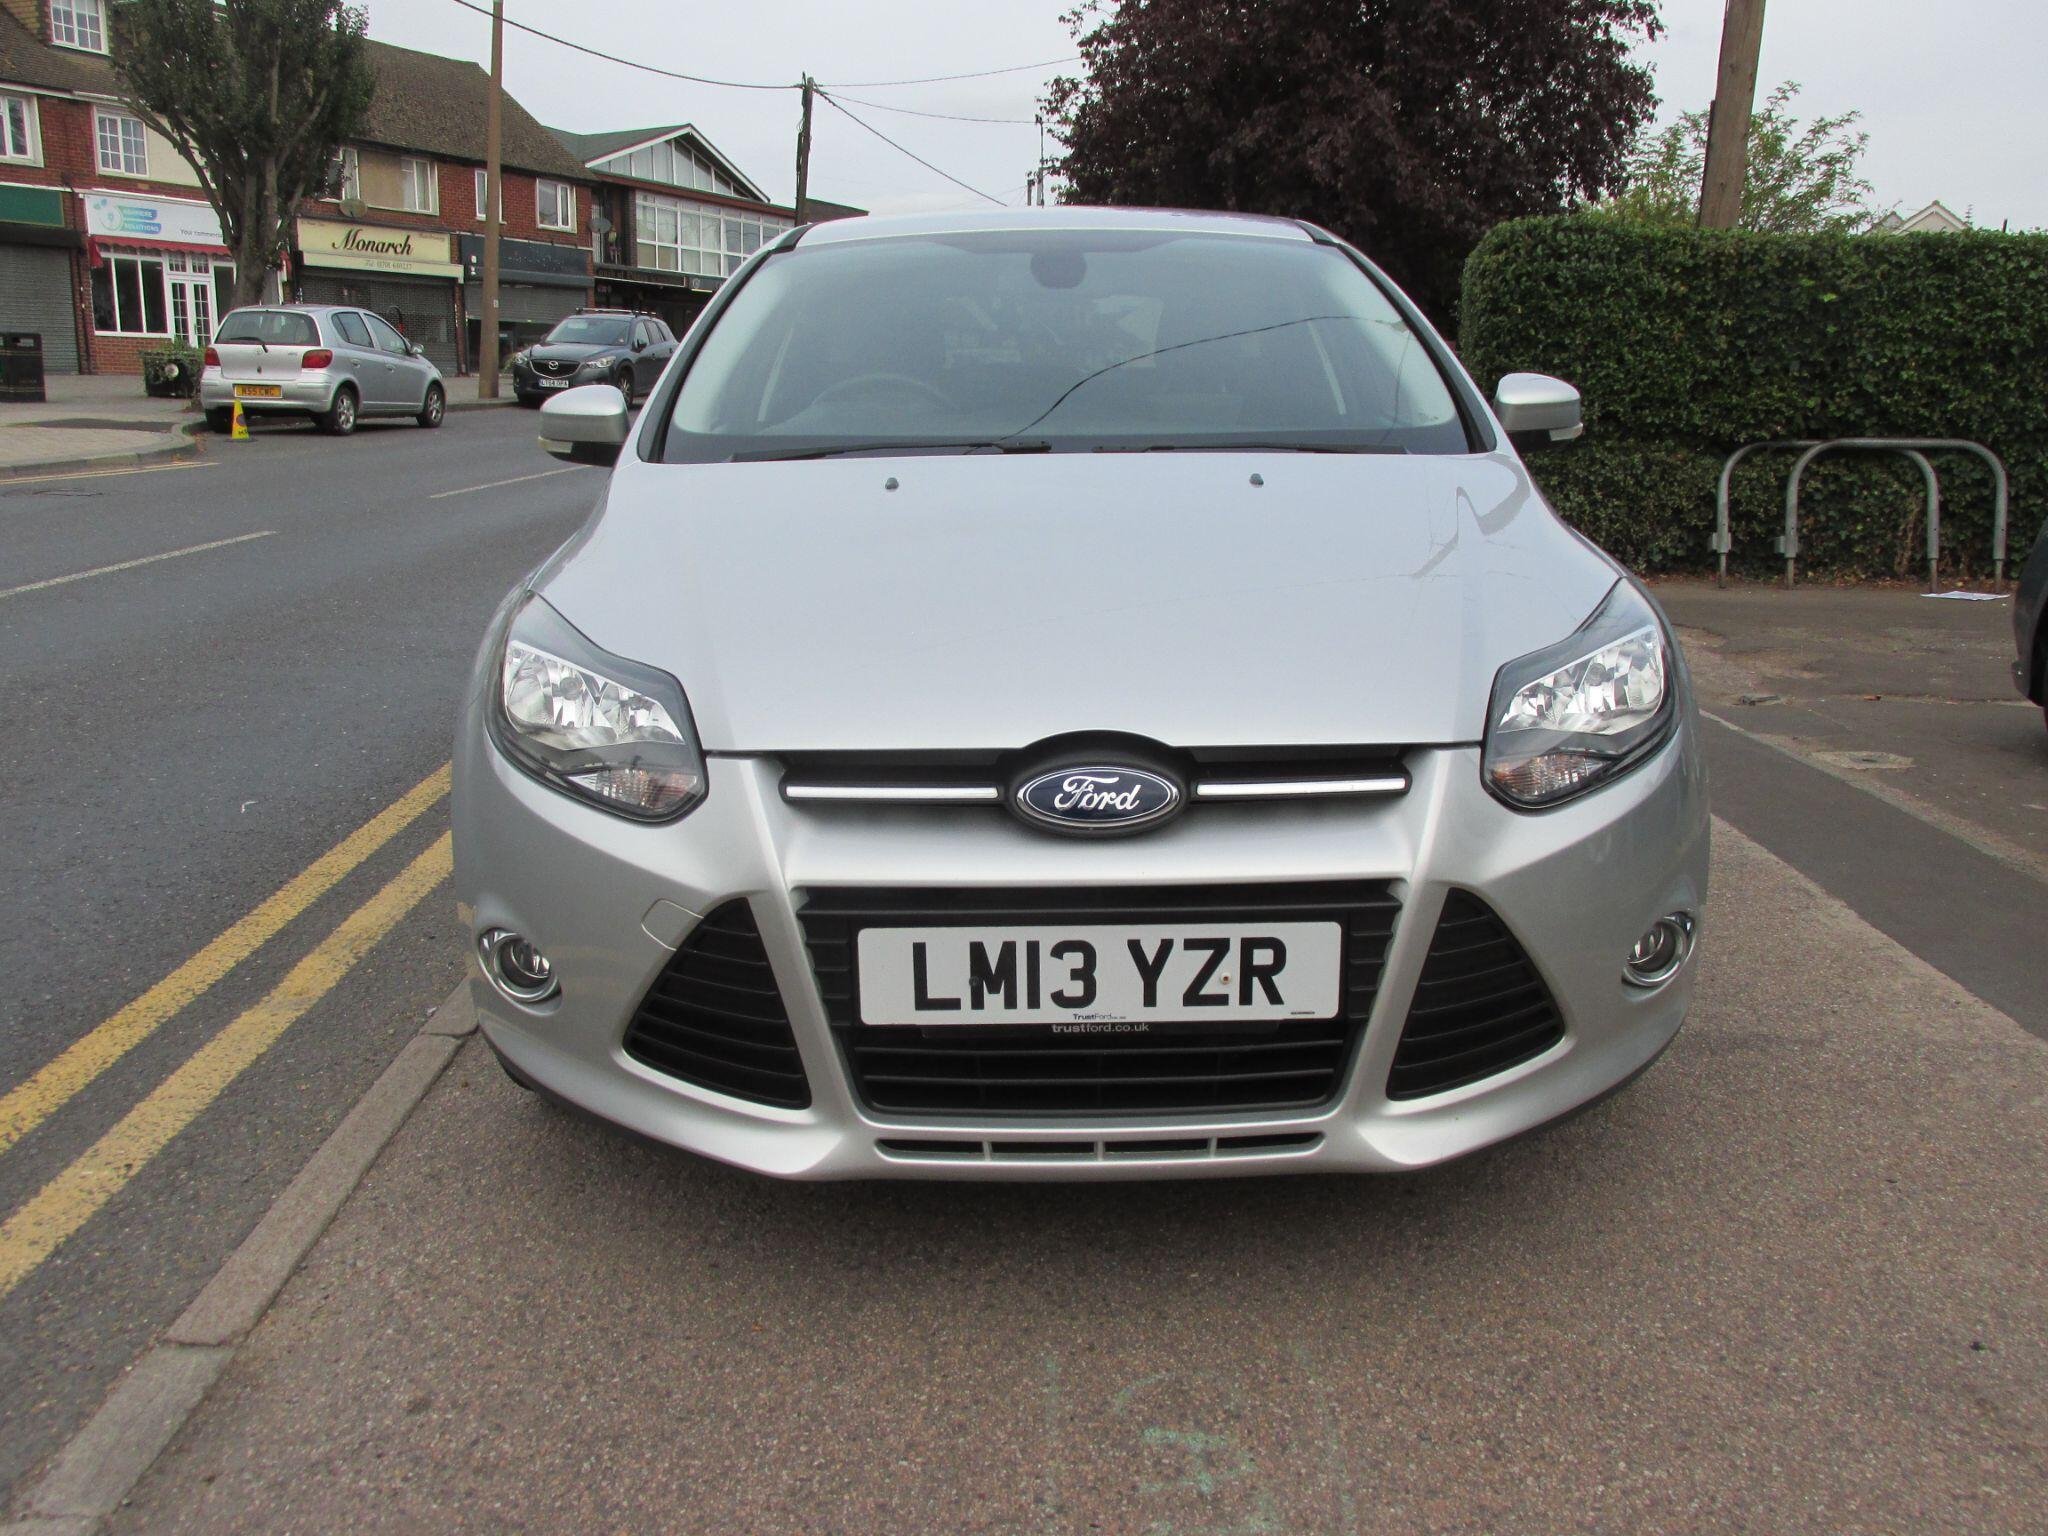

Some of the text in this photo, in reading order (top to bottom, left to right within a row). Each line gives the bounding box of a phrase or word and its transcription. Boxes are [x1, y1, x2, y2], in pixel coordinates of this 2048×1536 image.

[332, 228, 413, 256] Monarch
[1054, 775, 1141, 811] Ford
[912, 937, 1287, 1011] LM13 YZR
[1051, 1022, 1150, 1033] trustford.co.uk
